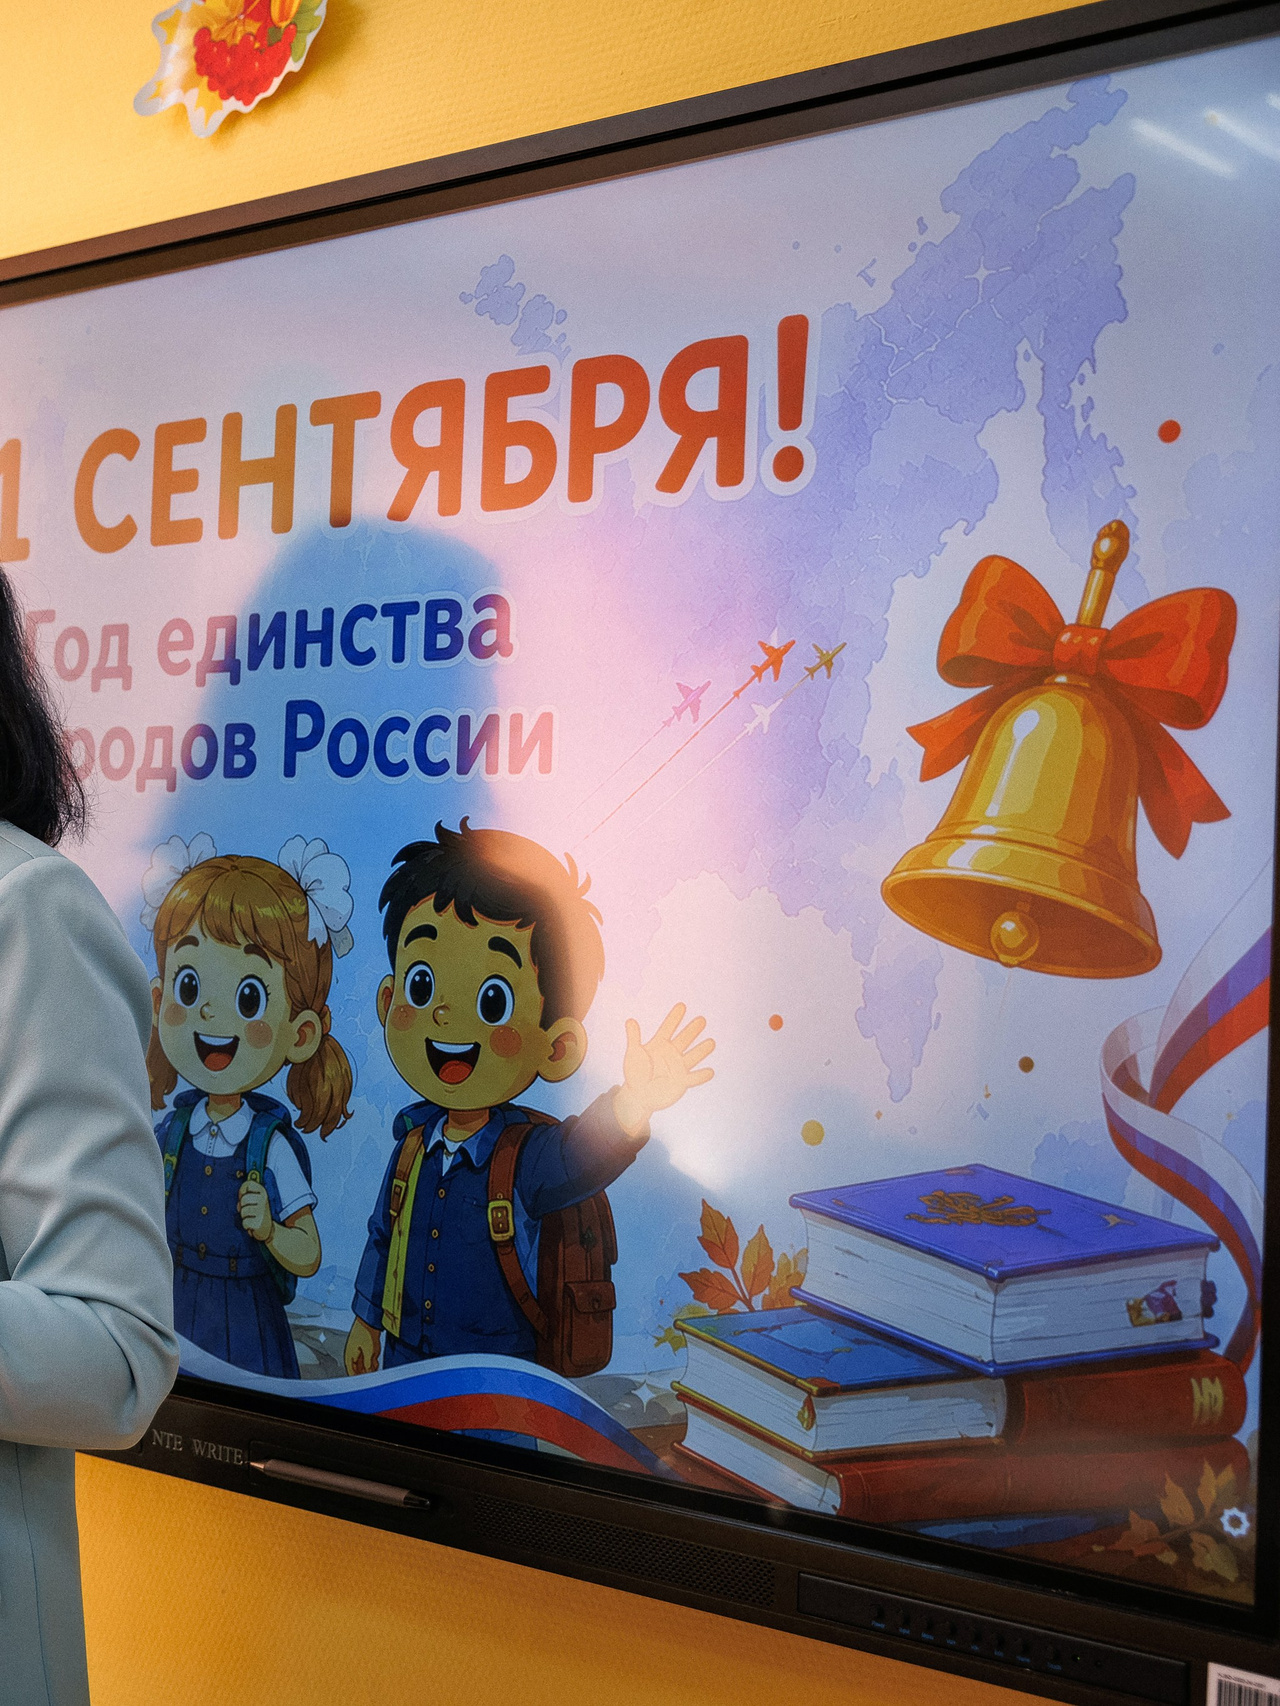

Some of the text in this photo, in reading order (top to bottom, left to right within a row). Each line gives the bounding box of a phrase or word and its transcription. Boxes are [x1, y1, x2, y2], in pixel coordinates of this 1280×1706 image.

[74, 313, 810, 555] СЕНТЯБРЯ!
[24, 593, 514, 693] Год единства
[61, 698, 554, 800] родов России
[192, 1438, 244, 1466] WRITE
